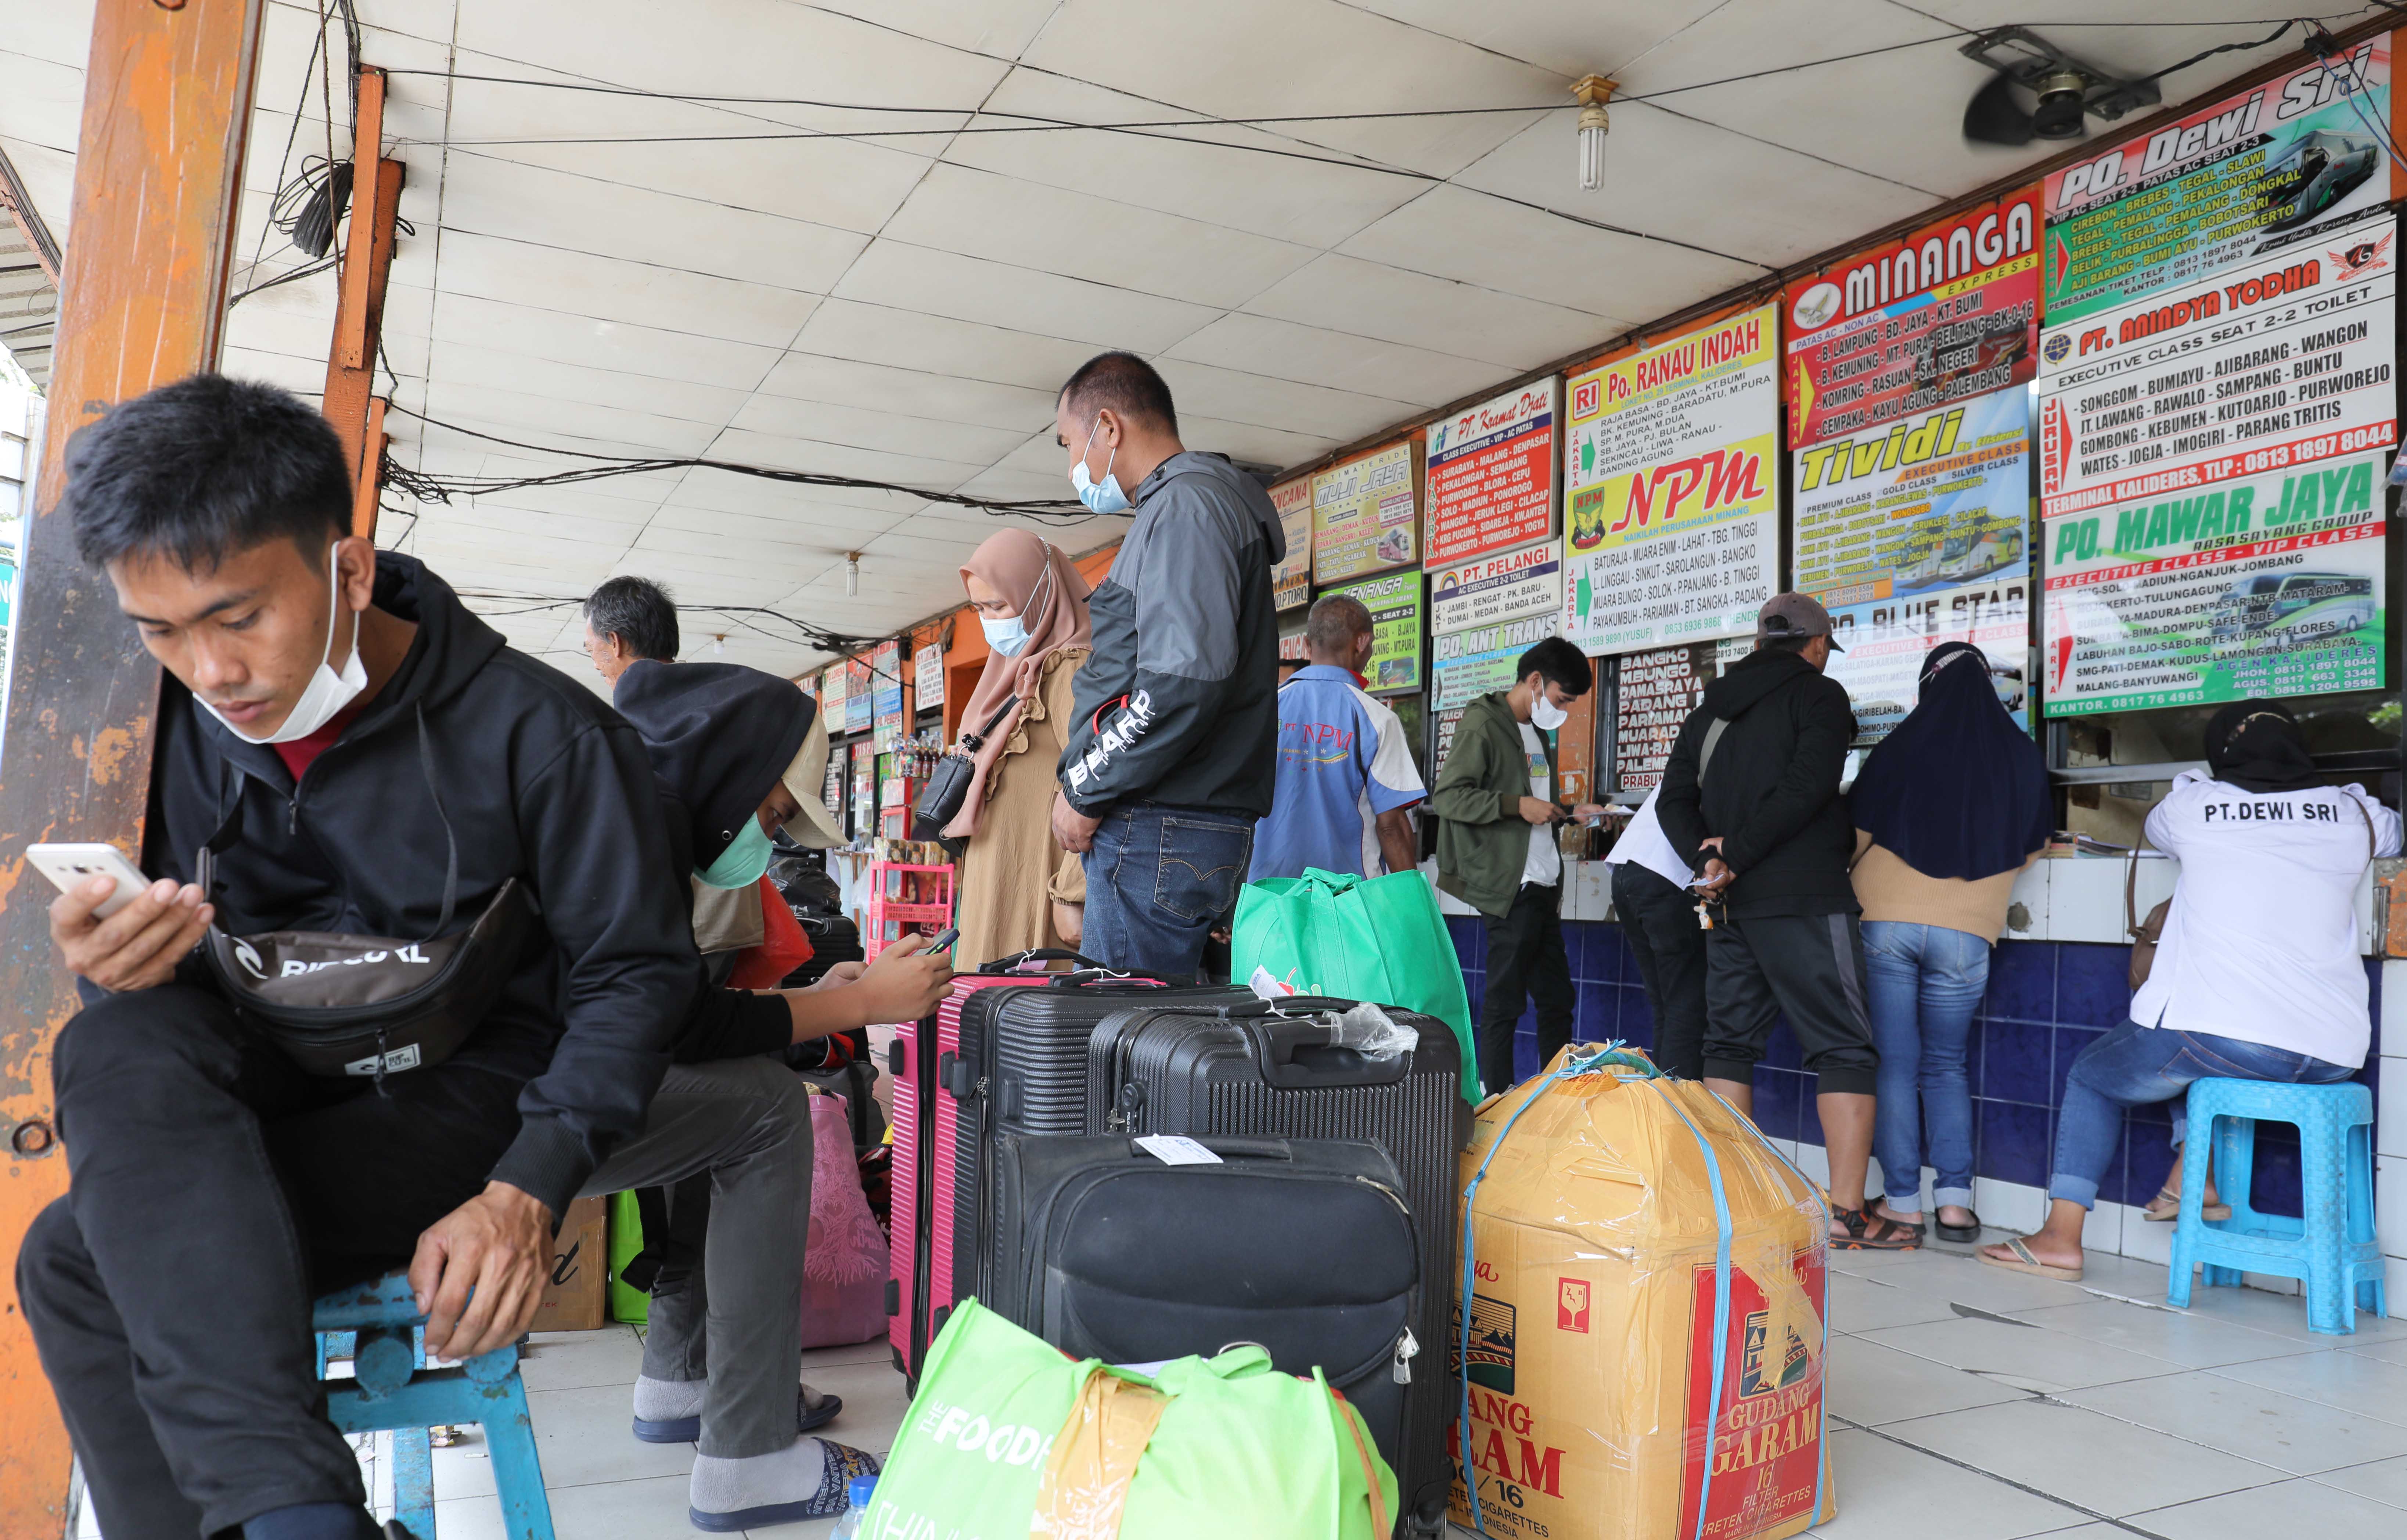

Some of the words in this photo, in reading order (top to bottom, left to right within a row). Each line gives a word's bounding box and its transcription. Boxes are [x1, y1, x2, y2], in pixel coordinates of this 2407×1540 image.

[2057, 150, 2128, 210] PO.
[2140, 89, 2266, 176] Dewi
[2277, 43, 2374, 120] Sri
[2052, 212, 2069, 224] VIP
[2071, 205, 2086, 217] AC
[2089, 192, 2118, 209] SEAT
[2122, 185, 2138, 197] 2-2
[2143, 169, 2180, 188] PATAS
[2183, 160, 2201, 174] AC
[2205, 147, 2237, 165] SEAT
[2241, 137, 2259, 151] 2-3
[2070, 207, 2117, 233] CIREBON
[2126, 188, 2169, 212] BREBES
[2178, 170, 2216, 192] TEGAL
[2227, 149, 2266, 174] SLAWI
[1845, 202, 2033, 318] MINANGA
[1947, 257, 2032, 296] EXPRESS
[1822, 345, 1831, 363] B.
[1832, 327, 1878, 360] LAMPUNG
[1886, 318, 1901, 340] BD.
[1904, 310, 1929, 335] JAYA
[1936, 304, 1953, 323] KT.
[1956, 291, 1983, 318] BUMI
[2080, 326, 2113, 356] PT.
[2120, 291, 2220, 344] ANINDYA
[2224, 259, 2320, 311] YODHA
[1796, 330, 1823, 349] PATAS
[1824, 327, 1837, 338] AC
[1844, 318, 1864, 332] NON
[1865, 312, 1879, 324] AC
[2058, 355, 2142, 387] EXECUTIVE
[2148, 337, 2203, 361] CLASS
[2211, 321, 2256, 343] SEAT
[2264, 310, 2296, 327] 2-2
[2305, 286, 2371, 315] TOILET
[1637, 343, 1695, 392] RANAU
[1701, 318, 1760, 369] INDAH
[2081, 385, 2138, 414] SONGGOM
[2148, 367, 2203, 395] BUMIAYU
[2214, 343, 2289, 378] AJIBARANG
[2302, 320, 2367, 353] WANGON
[1480, 403, 1517, 434] Kramat
[1520, 390, 1548, 420] Djati
[1576, 385, 1597, 407] RI
[1601, 414, 1623, 428] RAJA
[1625, 405, 1649, 419] BASA
[1656, 397, 1672, 408] BD.
[1674, 389, 1697, 402] JAYA
[1822, 415, 1865, 436] CEMPAKA
[1873, 403, 1898, 423] KAYU
[1901, 386, 1937, 412] AGUNG
[1945, 364, 2011, 402] PALEMBANG
[1442, 460, 1475, 480] SURABAYA
[1479, 448, 1508, 466] MALANG
[1513, 433, 1549, 455] DENPASAR
[1443, 449, 1459, 461] CLASS
[1460, 437, 1490, 458] EXECUTIVE
[1494, 432, 1504, 443] VIP
[1507, 428, 1515, 439] AC
[1516, 421, 1533, 435] PATAS
[1800, 407, 1965, 493] Tividi
[2082, 455, 2118, 476] WATES
[2129, 443, 2163, 465] JOGJA
[2174, 429, 2224, 454] IMOGIRI
[2237, 413, 2290, 440] PARANG
[2294, 400, 2341, 426] TRITIS
[1905, 451, 1974, 480] EXECUTIVE
[1978, 442, 2022, 461] CLASS
[2045, 487, 2114, 515] TERMINAL
[2117, 467, 2202, 499] KALIDERES,
[2204, 459, 2233, 477] TLP
[2245, 447, 2289, 472] 0813
[2292, 436, 2337, 461] 1897
[2341, 423, 2393, 451] 8044
[1577, 491, 1602, 509] NPM
[1807, 498, 1843, 514] PREMIUM
[1845, 492, 1872, 506] CLASS
[1882, 483, 1905, 496] GOLD
[1908, 476, 1937, 490] CLASS
[1951, 465, 1984, 479] SILVER
[1987, 456, 2019, 471] CLASS
[1623, 528, 1659, 542] NAIKILAH
[1661, 515, 1713, 533] PERUSAHAAN
[1716, 505, 1749, 521] MINANG
[1891, 504, 1931, 520] WONOSOBO
[2054, 517, 2102, 565] PO.
[2114, 486, 2255, 555] MAWAR
[2264, 461, 2373, 527] JAYA
[2193, 536, 2234, 551] RASA
[2239, 523, 2307, 544] SAYANG
[2312, 511, 2373, 531] GROUP
[1463, 566, 1482, 583] PT.
[1488, 547, 1549, 576] PELANGI
[1594, 551, 1628, 570] BATURAJA
[1633, 547, 1658, 562] MUARA
[1659, 541, 1676, 556] ENIM
[1682, 533, 1705, 552] LAHAT
[1712, 527, 1730, 544] TBG.
[1732, 522, 1757, 539] TINGGI
[2051, 562, 2154, 589] EXECUTIVE
[2160, 550, 2227, 571] CLASS
[2253, 540, 2288, 555] VIP
[2297, 525, 2374, 548] CLASS
[1467, 578, 1499, 593] EXECUTIVE
[1500, 575, 1509, 584] 2-2
[1509, 569, 1529, 581] TOILET
[1382, 612, 1400, 620] SEAT
[1402, 608, 1413, 616] 2-2
[1467, 626, 1500, 655] ANT
[1504, 613, 1558, 648] TRANS
[1621, 649, 1688, 670] BANGKO
[1619, 676, 1702, 699] DAMASRAYA
[1619, 693, 1687, 714] PADANG
[2050, 700, 2108, 714] KANTOR.
[2112, 696, 2143, 708] 0817
[2148, 693, 2165, 704] 76
[2169, 690, 2204, 702] 4963
[1302, 723, 1354, 750] NPM
[2304, 804, 2339, 822] SRI
[917, 1400, 949, 1435] THE
[1728, 1381, 1811, 1431] GUDANG
[1710, 1402, 1820, 1477] GARAM
[1496, 1480, 1524, 1508] 16
[1742, 1485, 1778, 1509] FILTER
[1756, 1464, 1773, 1491] 16
[1478, 1497, 1549, 1538] CIGARETTES
[1746, 1485, 1811, 1521] CIGARETTES
[1724, 1526, 1742, 1539] MADE
